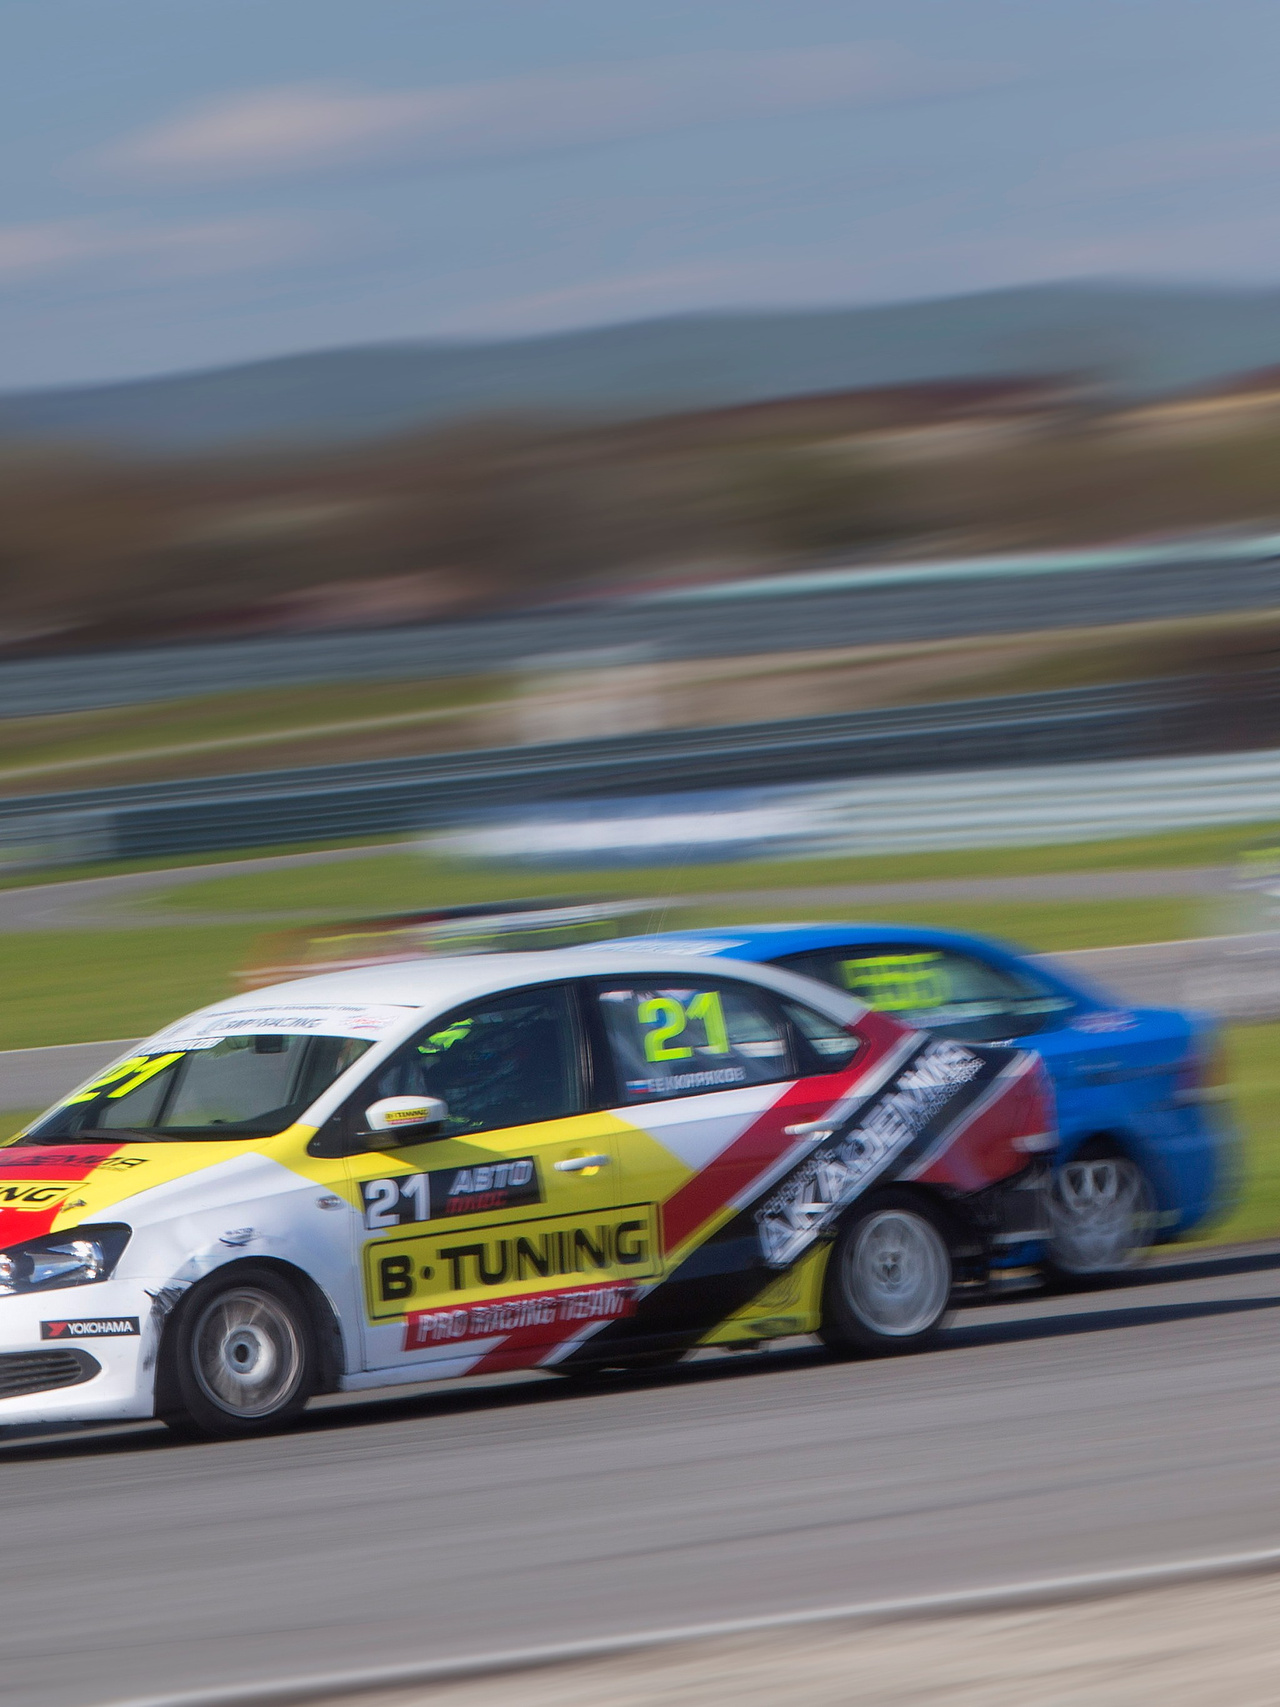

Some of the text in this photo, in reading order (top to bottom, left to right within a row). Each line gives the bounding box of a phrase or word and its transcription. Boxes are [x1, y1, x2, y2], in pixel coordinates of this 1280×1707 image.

[637, 991, 730, 1063] 21
[62, 1051, 187, 1105] 21
[364, 1172, 431, 1229] 21
[448, 1160, 534, 1196] АВТО
[66, 1320, 135, 1335] YOKOHAMA
[416, 1286, 637, 1343] PRO RACING TEAM
